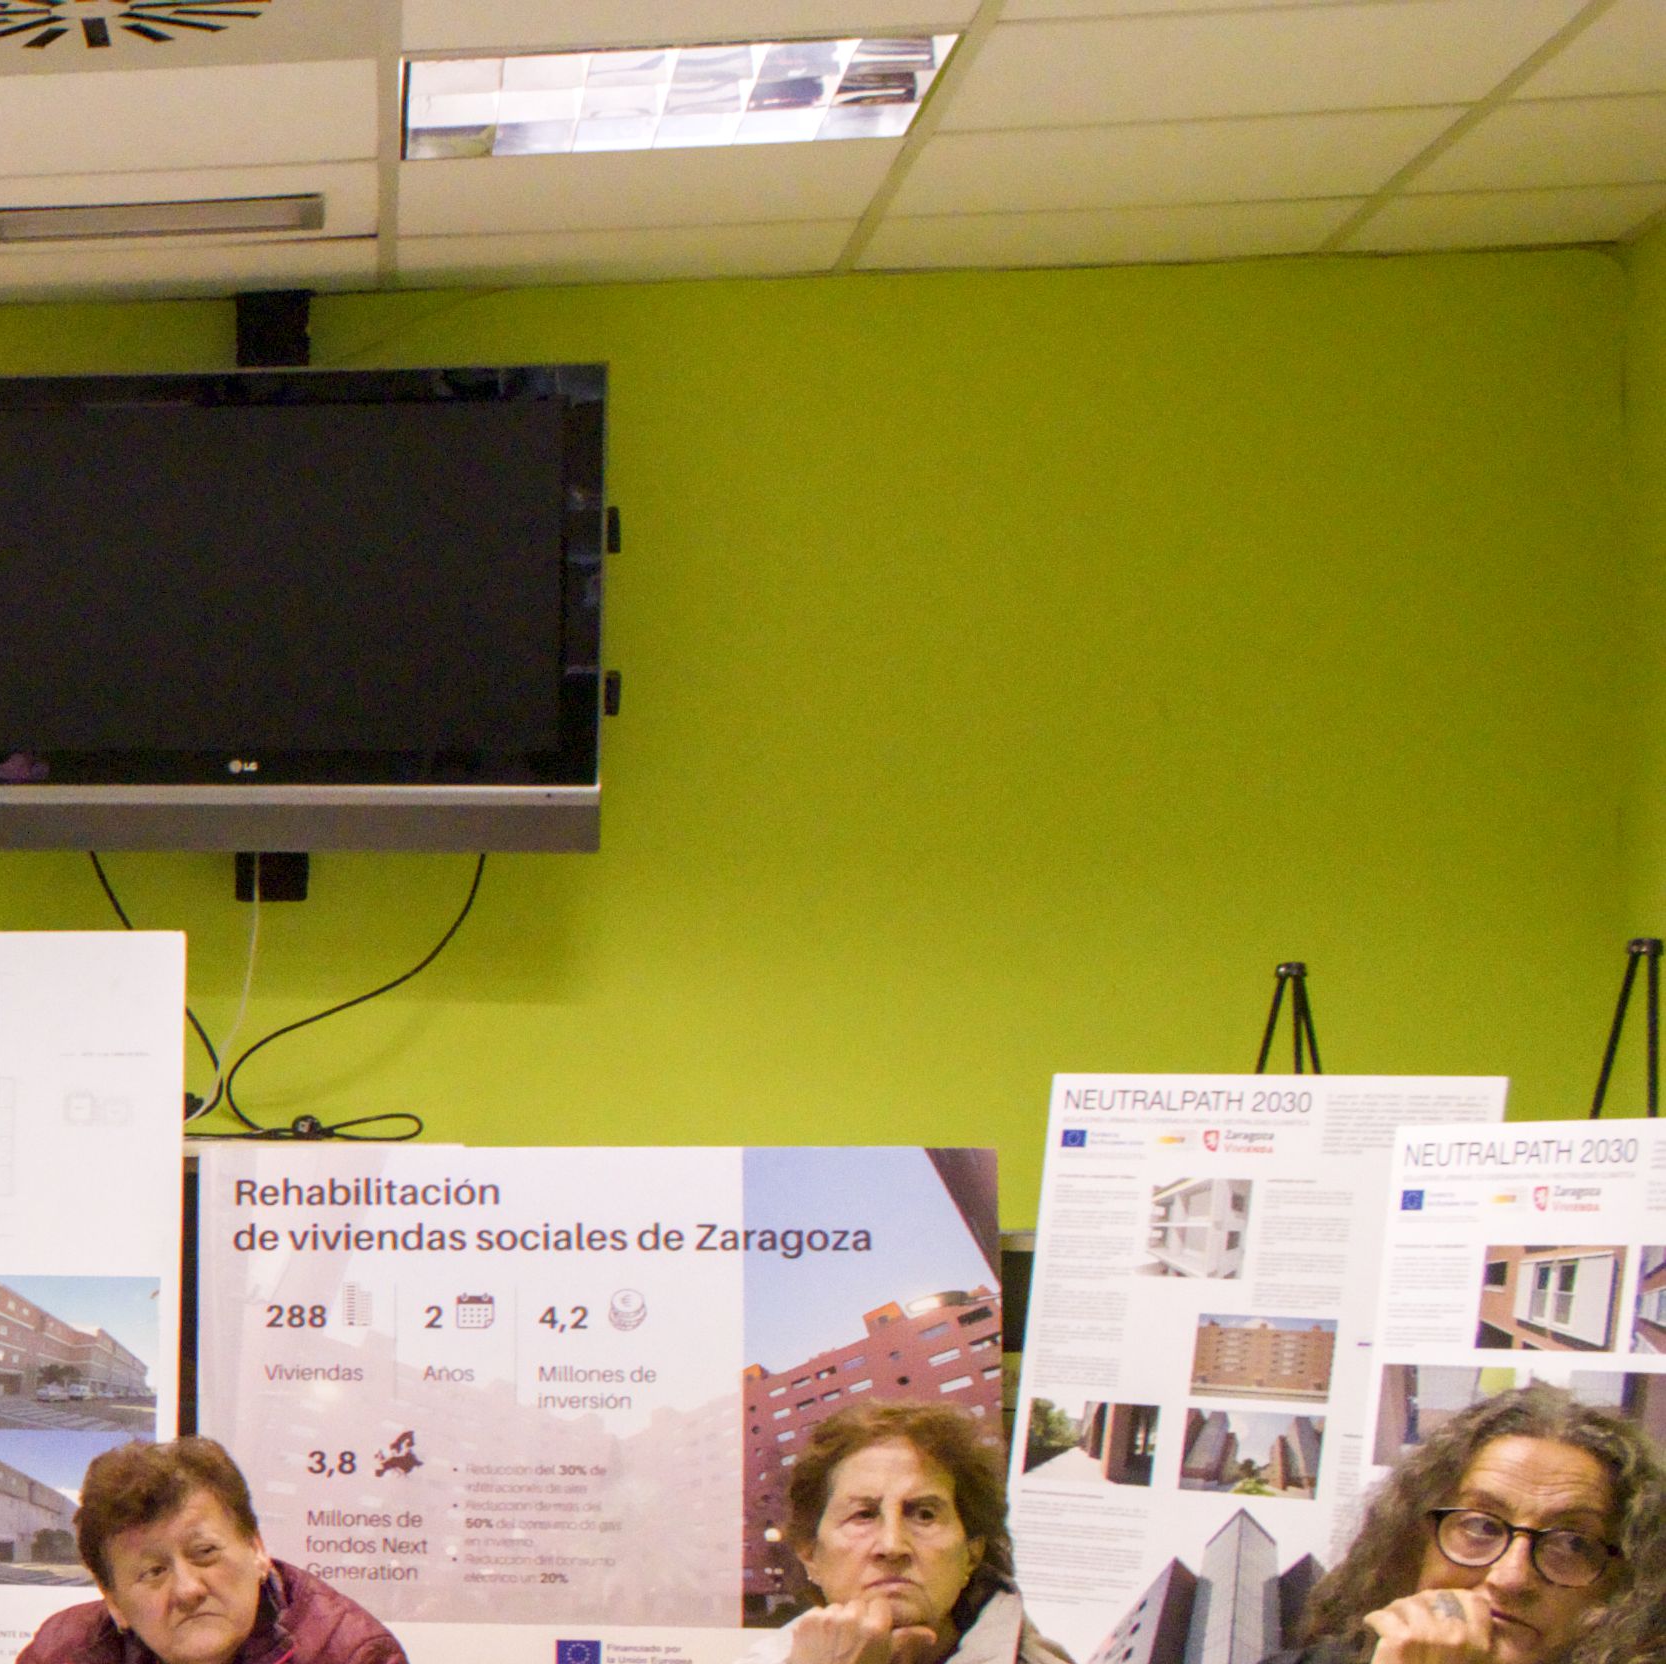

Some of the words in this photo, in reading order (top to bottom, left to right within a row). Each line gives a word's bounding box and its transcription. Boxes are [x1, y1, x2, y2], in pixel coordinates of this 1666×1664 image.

[1063, 1088, 1244, 1113] NEUTRALPATH
[1251, 1090, 1313, 1114] 2030
[1403, 1139, 1574, 1168] NEUTRALPATH
[1580, 1137, 1639, 1165] 2030
[234, 1177, 501, 1206] Rehabilitación
[232, 1222, 280, 1251] de
[288, 1222, 467, 1251] viviendas
[475, 1222, 628, 1252] sociales
[637, 1222, 685, 1252] de
[694, 1223, 873, 1260] Zaragoza
[265, 1304, 328, 1329] 288
[424, 1305, 444, 1330] 2
[538, 1305, 590, 1334] 4,2
[263, 1362, 364, 1383] Viviendas
[423, 1363, 475, 1383] Años
[537, 1365, 625, 1385] Millones
[630, 1365, 657, 1385] de
[537, 1392, 632, 1411] inversión
[307, 1450, 357, 1478] 3,8
[558, 1464, 587, 1476] 30%
[307, 1509, 392, 1528] Millones
[396, 1511, 423, 1528] de
[465, 1517, 493, 1529] 50%
[305, 1535, 377, 1553] fondos
[381, 1537, 428, 1555] Next
[307, 1562, 418, 1581] Generation
[606, 1643, 662, 1653] Financiado
[665, 1645, 682, 1655] por
